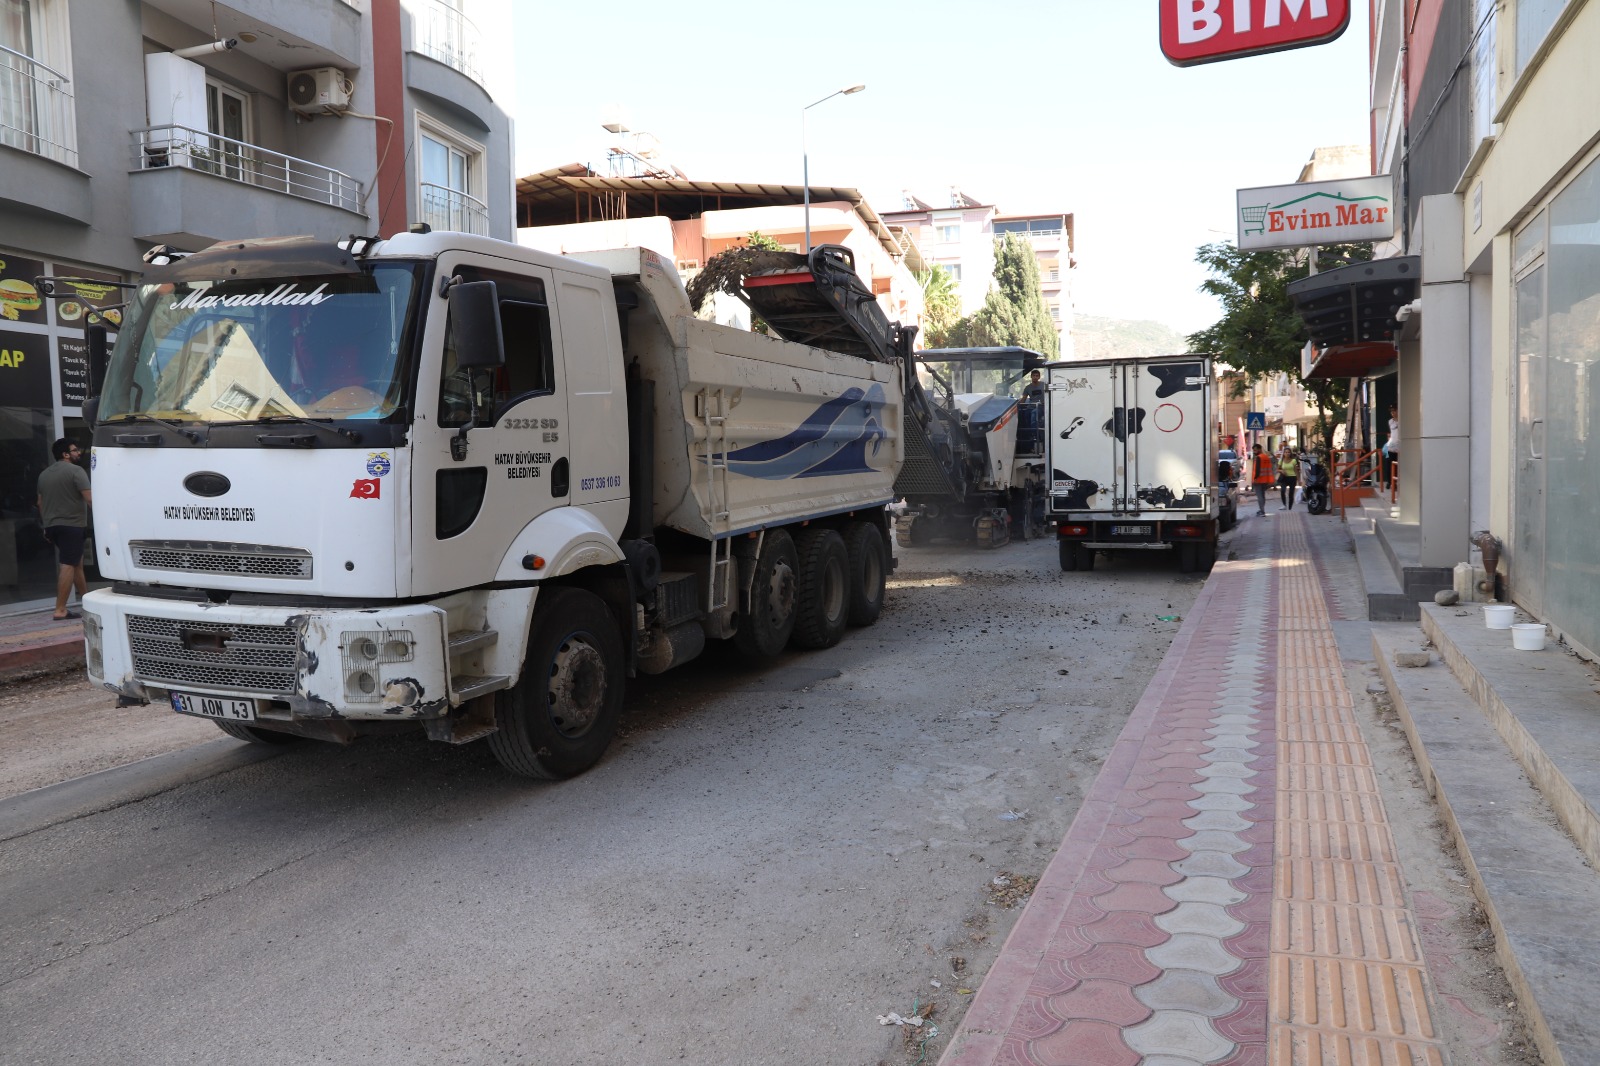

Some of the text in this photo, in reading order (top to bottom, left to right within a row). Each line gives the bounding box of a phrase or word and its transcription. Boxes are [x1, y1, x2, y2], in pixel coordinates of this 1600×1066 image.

[1267, 203, 1389, 233] Evim Mar
[504, 418, 559, 429] 3232 SD
[542, 432, 559, 443] E5
[494, 453, 514, 465] HATAY
[581, 478, 594, 490] 0537
[607, 476, 613, 487] 10
[614, 475, 621, 487] 63
[163, 506, 181, 520] HATAY
[178, 694, 249, 719] 31 AON 43
